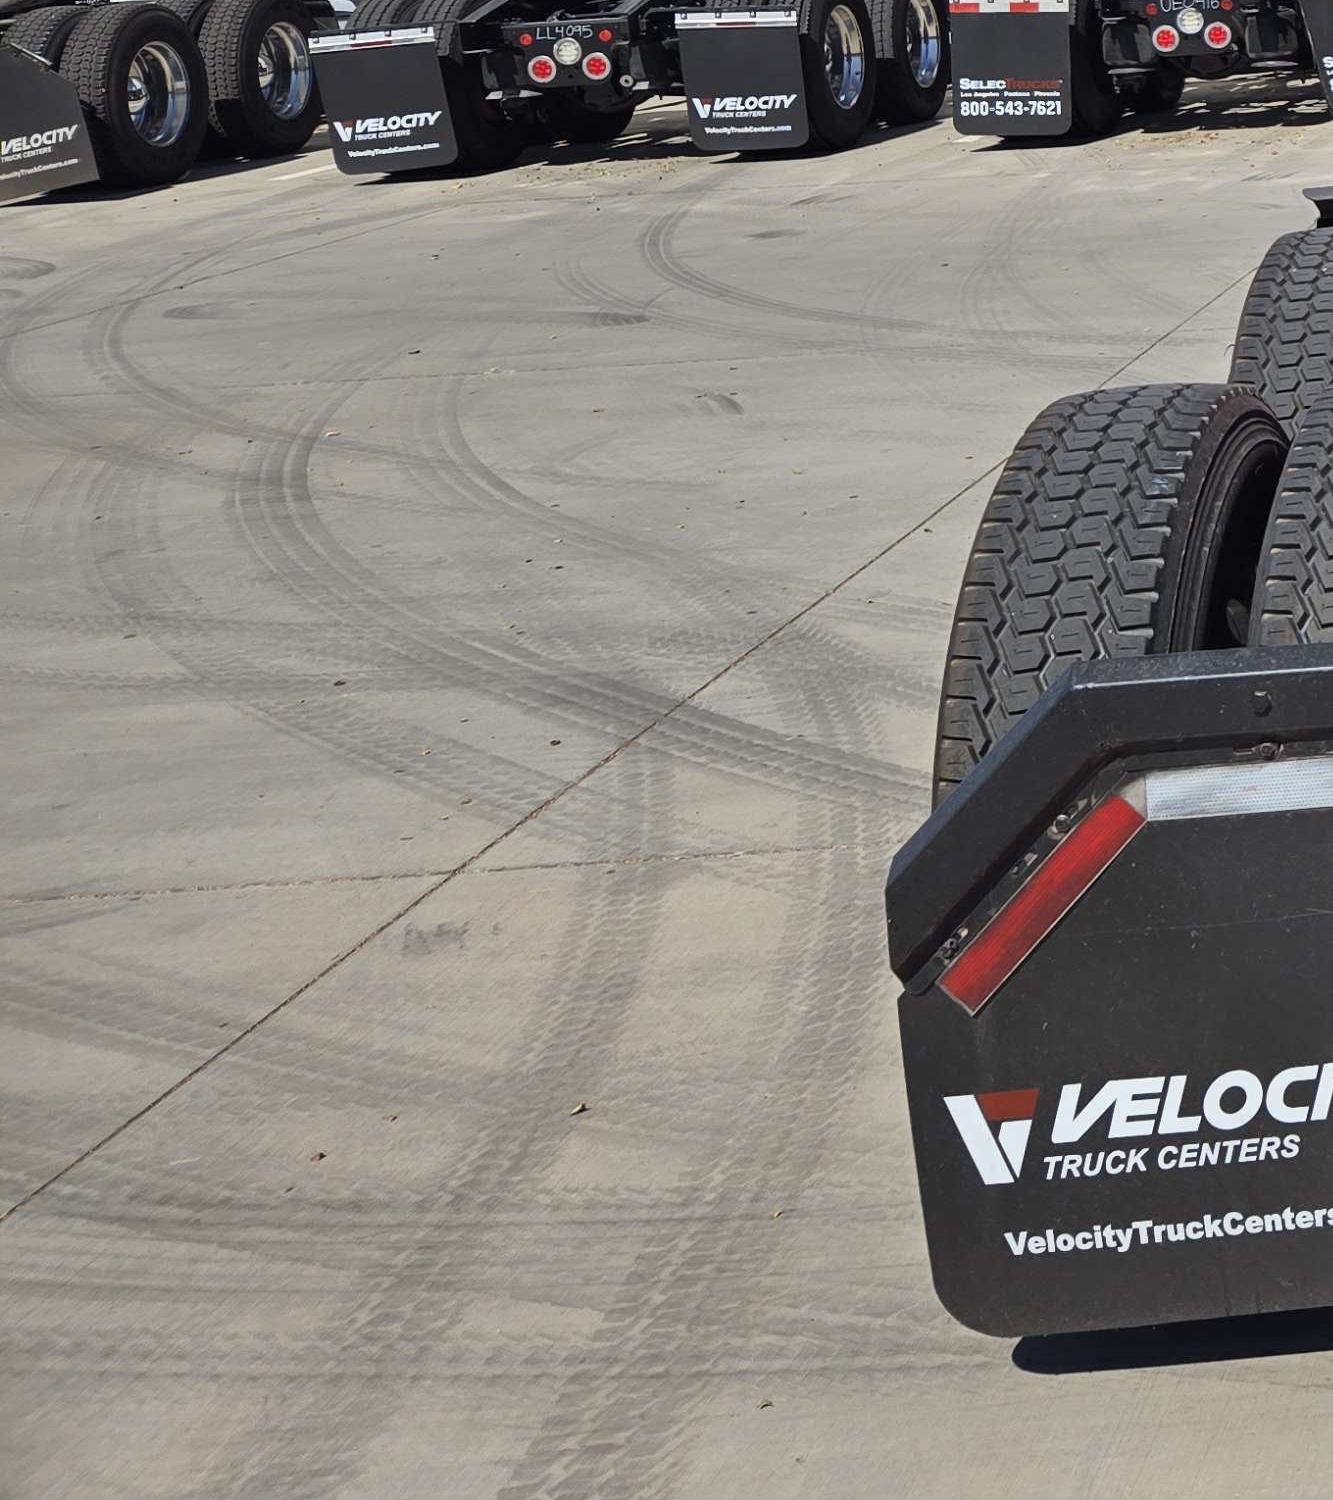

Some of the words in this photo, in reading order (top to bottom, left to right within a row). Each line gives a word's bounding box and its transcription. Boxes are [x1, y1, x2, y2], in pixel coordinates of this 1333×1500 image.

[536, 24, 593, 40] LL4095
[713, 94, 798, 111] VELOCITY
[960, 100, 1062, 116] 800-543-7621
[355, 110, 443, 133] VELOCITY
[1, 124, 78, 155] VELOCITY
[354, 132, 377, 141] TRUCK
[378, 129, 411, 139] CENTERS
[1043, 1147, 1149, 1180] TRUCK
[1157, 1133, 1301, 1170] CENTERS
